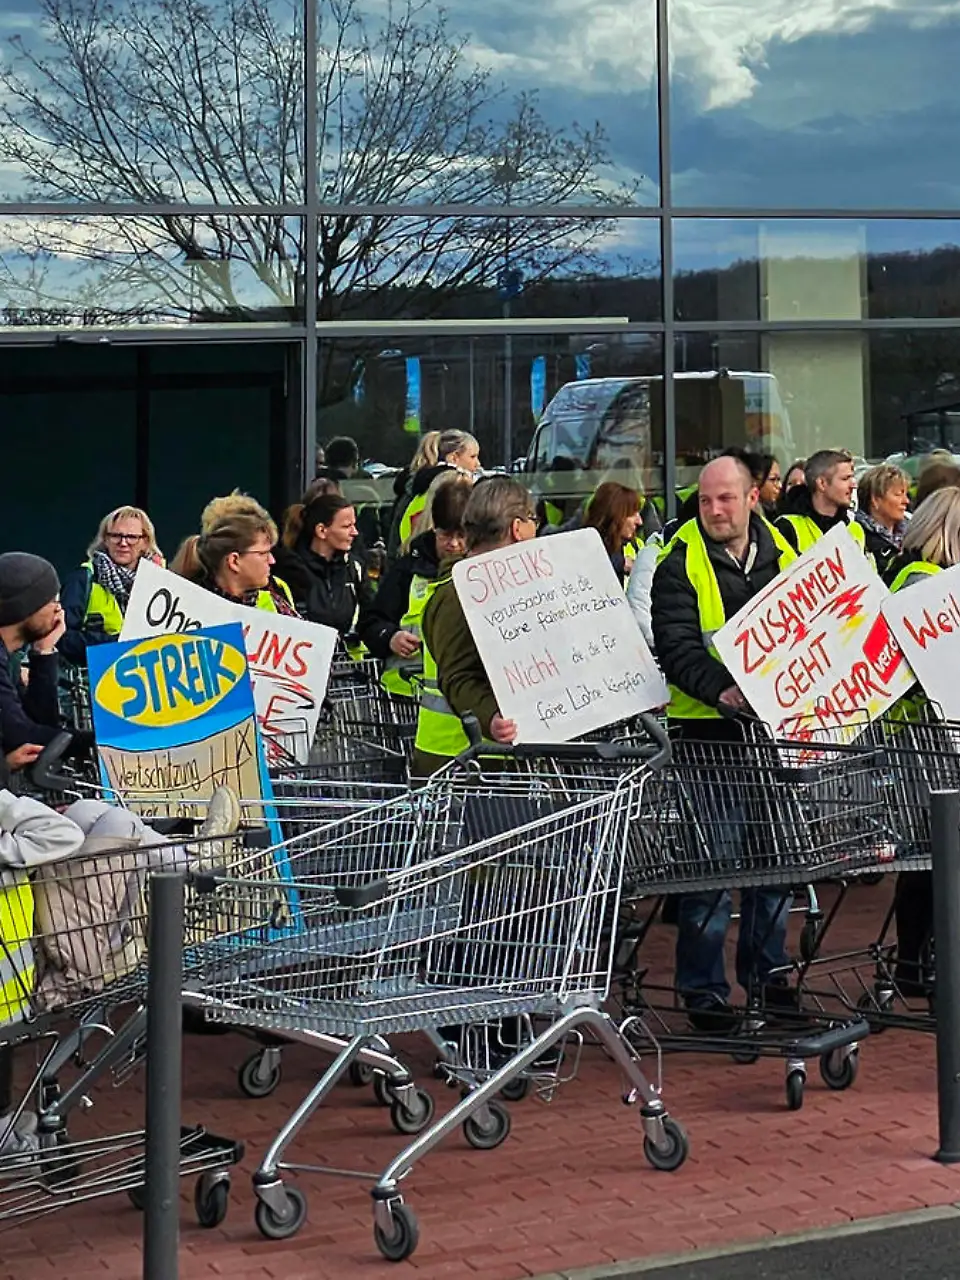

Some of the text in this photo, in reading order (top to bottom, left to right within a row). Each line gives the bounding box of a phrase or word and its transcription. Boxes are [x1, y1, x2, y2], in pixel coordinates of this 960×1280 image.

[466, 548, 554, 603] STREIKS
[146, 588, 202, 634] Ohn
[734, 547, 847, 674] ZUSAMMEN
[115, 638, 236, 718] STREIK
[504, 646, 560, 695] Nicht
[775, 631, 831, 708] GEHT
[814, 661, 892, 732] MEHR
[536, 701, 567, 730] faire
